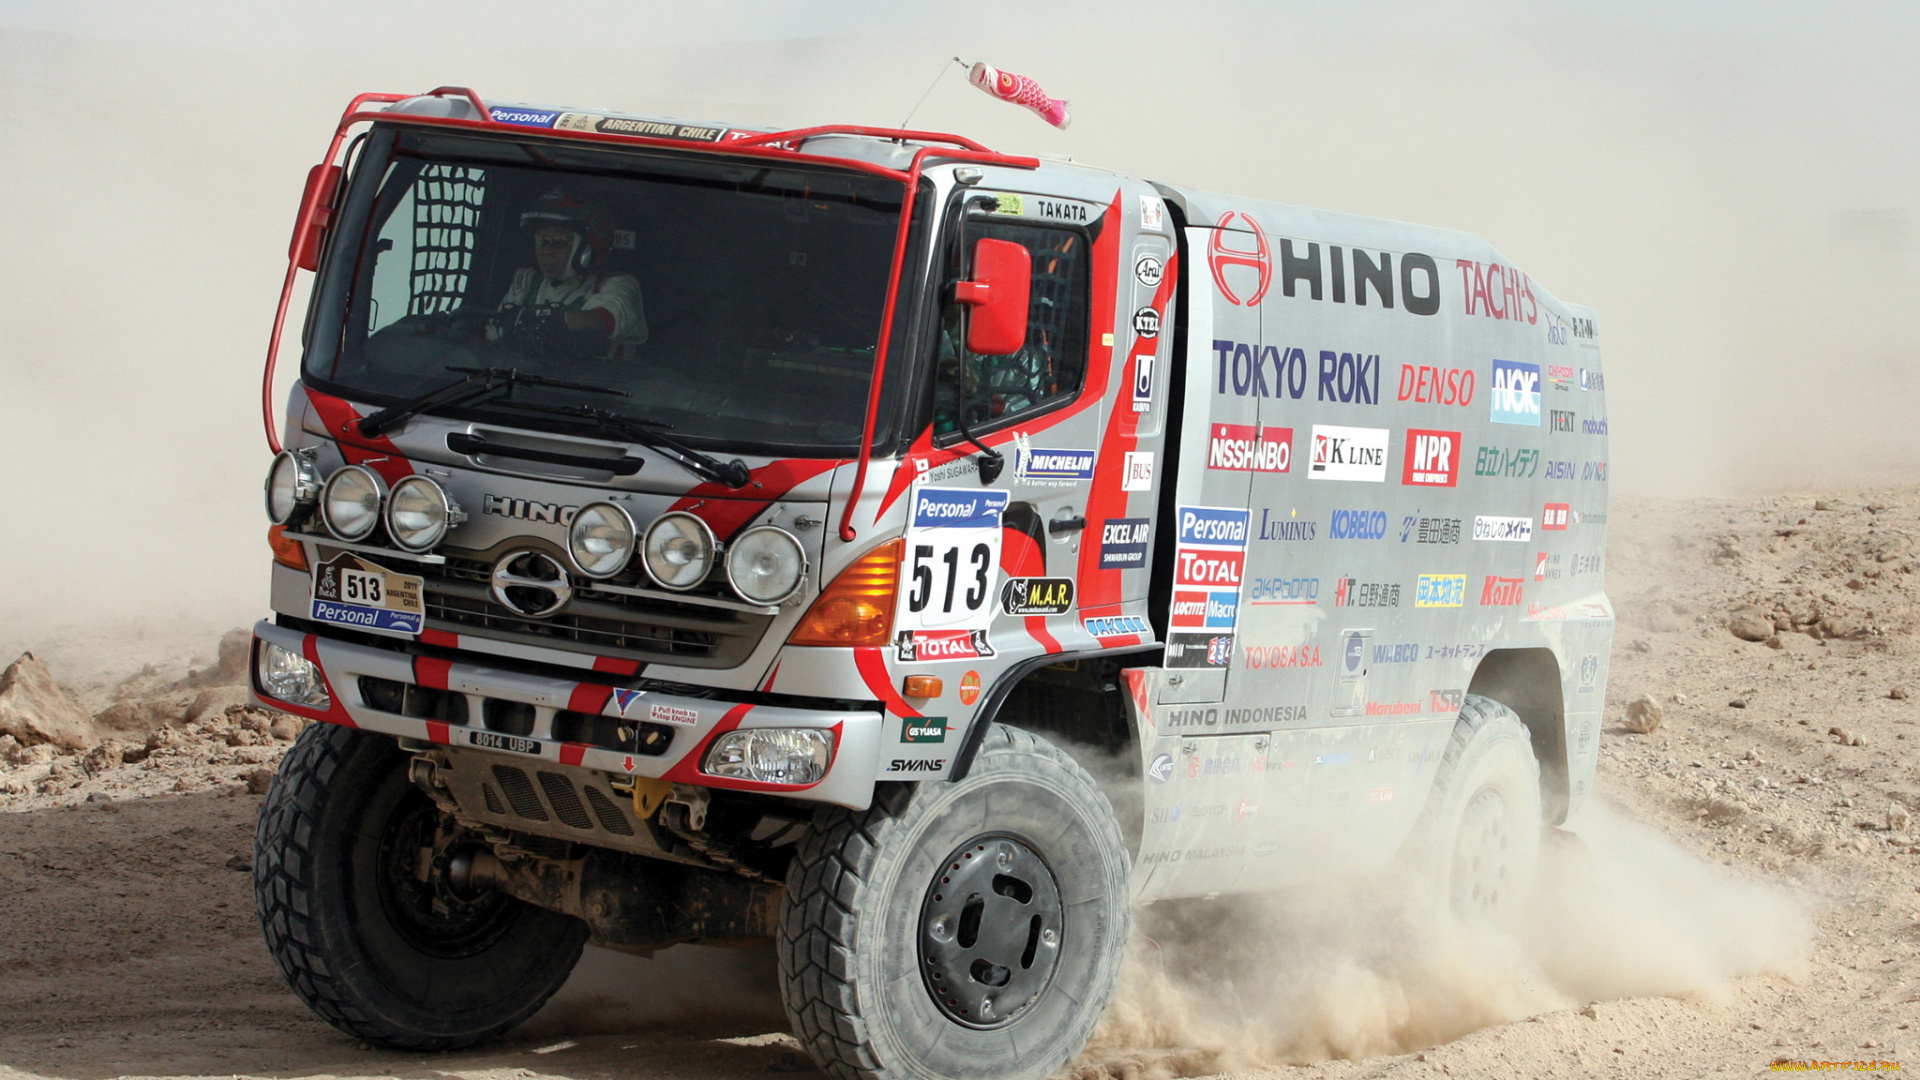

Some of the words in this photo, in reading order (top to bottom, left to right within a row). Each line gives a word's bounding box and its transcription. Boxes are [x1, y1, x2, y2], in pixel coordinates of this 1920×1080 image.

[491, 110, 555, 124] Personal
[602, 119, 675, 136] ARGENTINA
[678, 126, 717, 140] CHILE
[730, 131, 794, 151] TAL
[1038, 201, 1087, 222] TAKATA
[1138, 261, 1160, 278] Arai
[1280, 238, 1440, 316] HINO
[1456, 259, 1538, 325] TACHI-S
[1136, 316, 1160, 332] KTEL
[1212, 339, 1307, 399] TOKYO
[1318, 350, 1380, 405] ROKI
[1397, 364, 1475, 407] DENSO
[1494, 368, 1539, 414] NOK
[1549, 409, 1575, 435] JTEKT
[1582, 414, 1608, 436] mabuchi
[1031, 455, 1093, 471] MICHELIN
[1349, 447, 1383, 465] LINE
[1413, 435, 1452, 472] NPR
[1475, 446, 1540, 478] 日立ハイテク
[930, 468, 945, 482] Yoshi
[1545, 460, 1576, 480] AISIN
[918, 498, 977, 518] Personal
[985, 499, 1006, 508] Personal
[1102, 524, 1131, 545] EXCEL
[1131, 523, 1150, 544] AIR
[1181, 512, 1247, 541] Personal
[1329, 509, 1388, 540] KOBELCO
[1417, 517, 1462, 545] 豊田通商
[1127, 552, 1142, 562] GROUP
[1181, 552, 1240, 582] TOTAL
[347, 574, 381, 602] 513
[403, 581, 418, 591] 2011
[909, 543, 991, 613] 513
[386, 589, 417, 600] ARGENTINA
[403, 599, 418, 608] CHILE
[1028, 584, 1068, 606] M.A.R.
[1359, 583, 1401, 608] 日野通商
[316, 603, 379, 626] Personal
[390, 612, 416, 621] Personal
[1174, 601, 1206, 615] LOCTITE
[914, 636, 974, 656] TOTAL
[1373, 643, 1419, 664] WABCO
[1245, 646, 1297, 670] TOYOSA
[1300, 645, 1323, 668] S.A.
[1365, 700, 1422, 716] Marubeni
[1430, 689, 1463, 713] TSB
[657, 713, 671, 721] stop
[672, 715, 696, 725] ENGINE
[672, 708, 688, 716] knob
[1168, 709, 1218, 727] HINO
[1224, 704, 1307, 726] INDONESIA
[909, 727, 919, 736] GS
[919, 727, 941, 736] YUASA
[476, 732, 502, 748] 8014
[509, 738, 534, 753] UBP
[890, 759, 943, 771] SWANS
[1143, 850, 1181, 865] HINO
[1184, 846, 1245, 860] MALAYSIA
